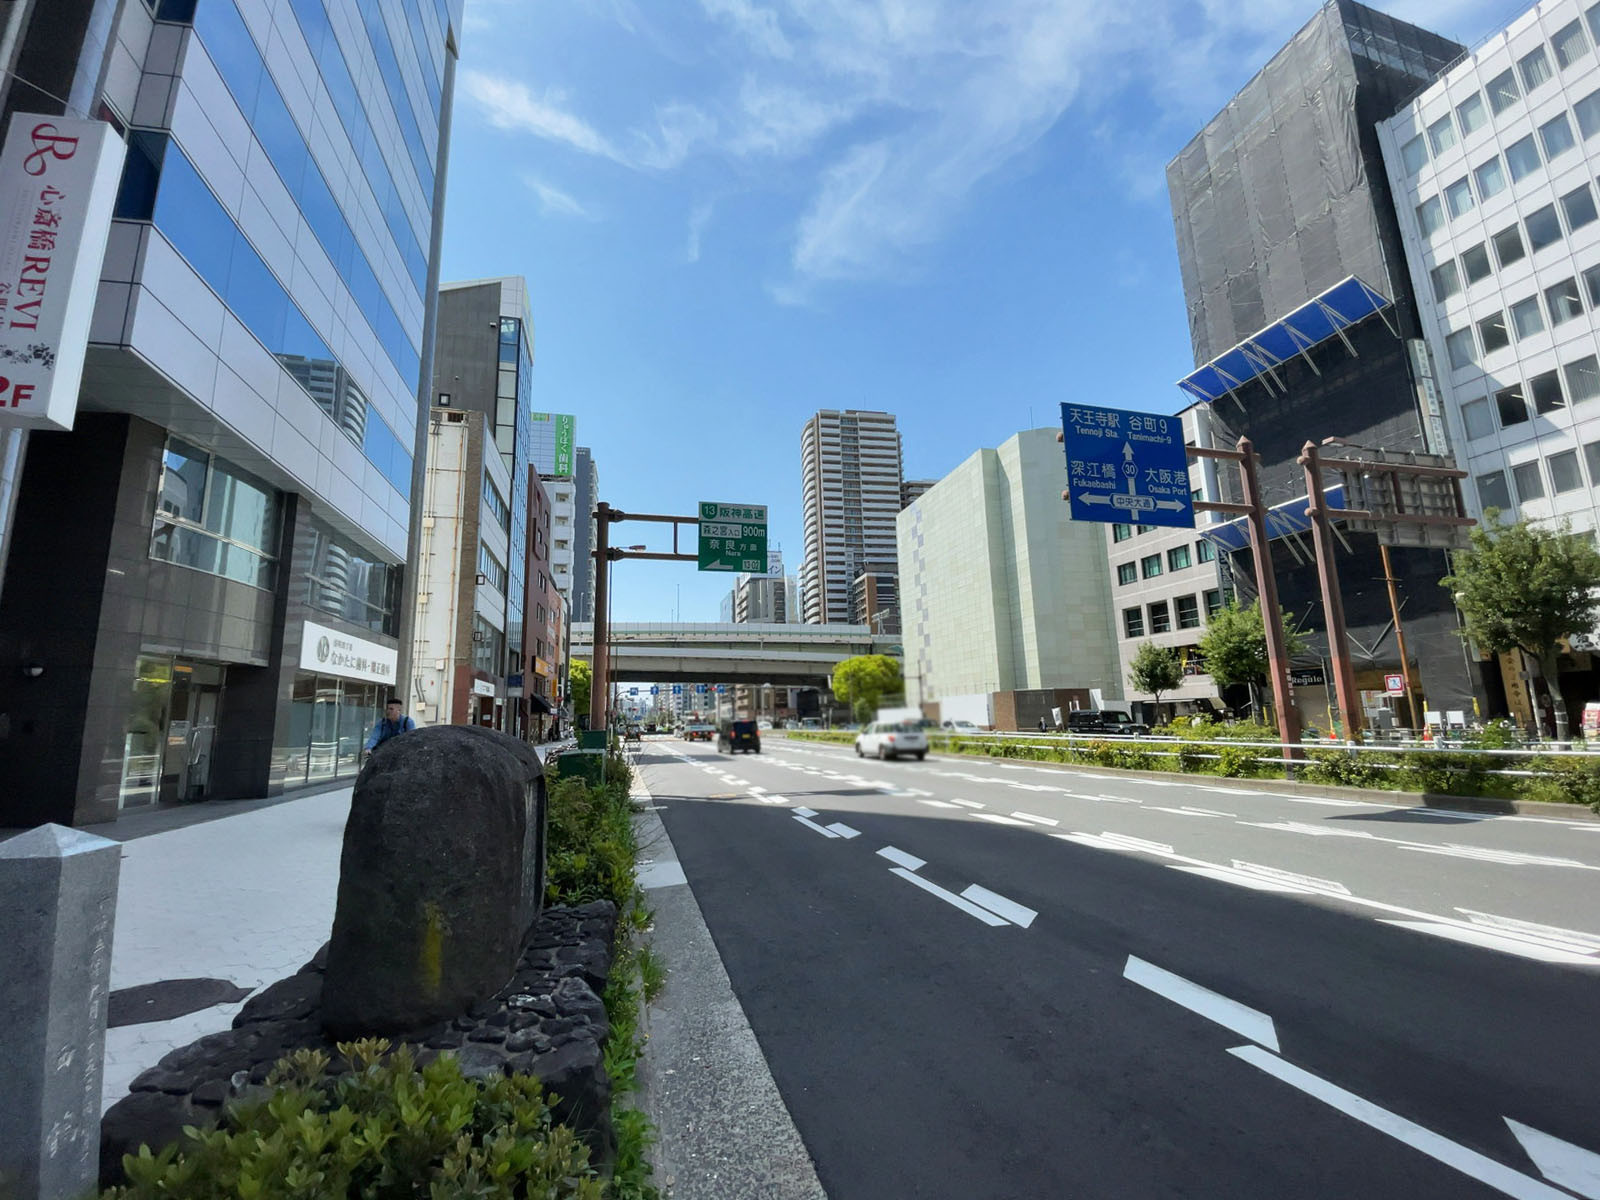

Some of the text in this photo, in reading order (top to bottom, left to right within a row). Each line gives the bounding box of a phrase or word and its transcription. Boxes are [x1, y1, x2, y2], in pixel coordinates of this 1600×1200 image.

[1069, 407, 1168, 434] 天王寺駅 谷町9
[1075, 425, 1120, 439] Tennoji Sta.
[1128, 432, 1171, 444] Tanimachi-9
[1070, 460, 1117, 479] 深江橋
[1125, 464, 1136, 475] 30
[1144, 467, 1187, 486] 大阪港
[1073, 477, 1117, 490] Fukaebashi
[1148, 484, 1188, 496] Osaka Port
[704, 505, 716, 516] 13
[719, 507, 765, 520] 阪神高速
[742, 526, 766, 537] 900m
